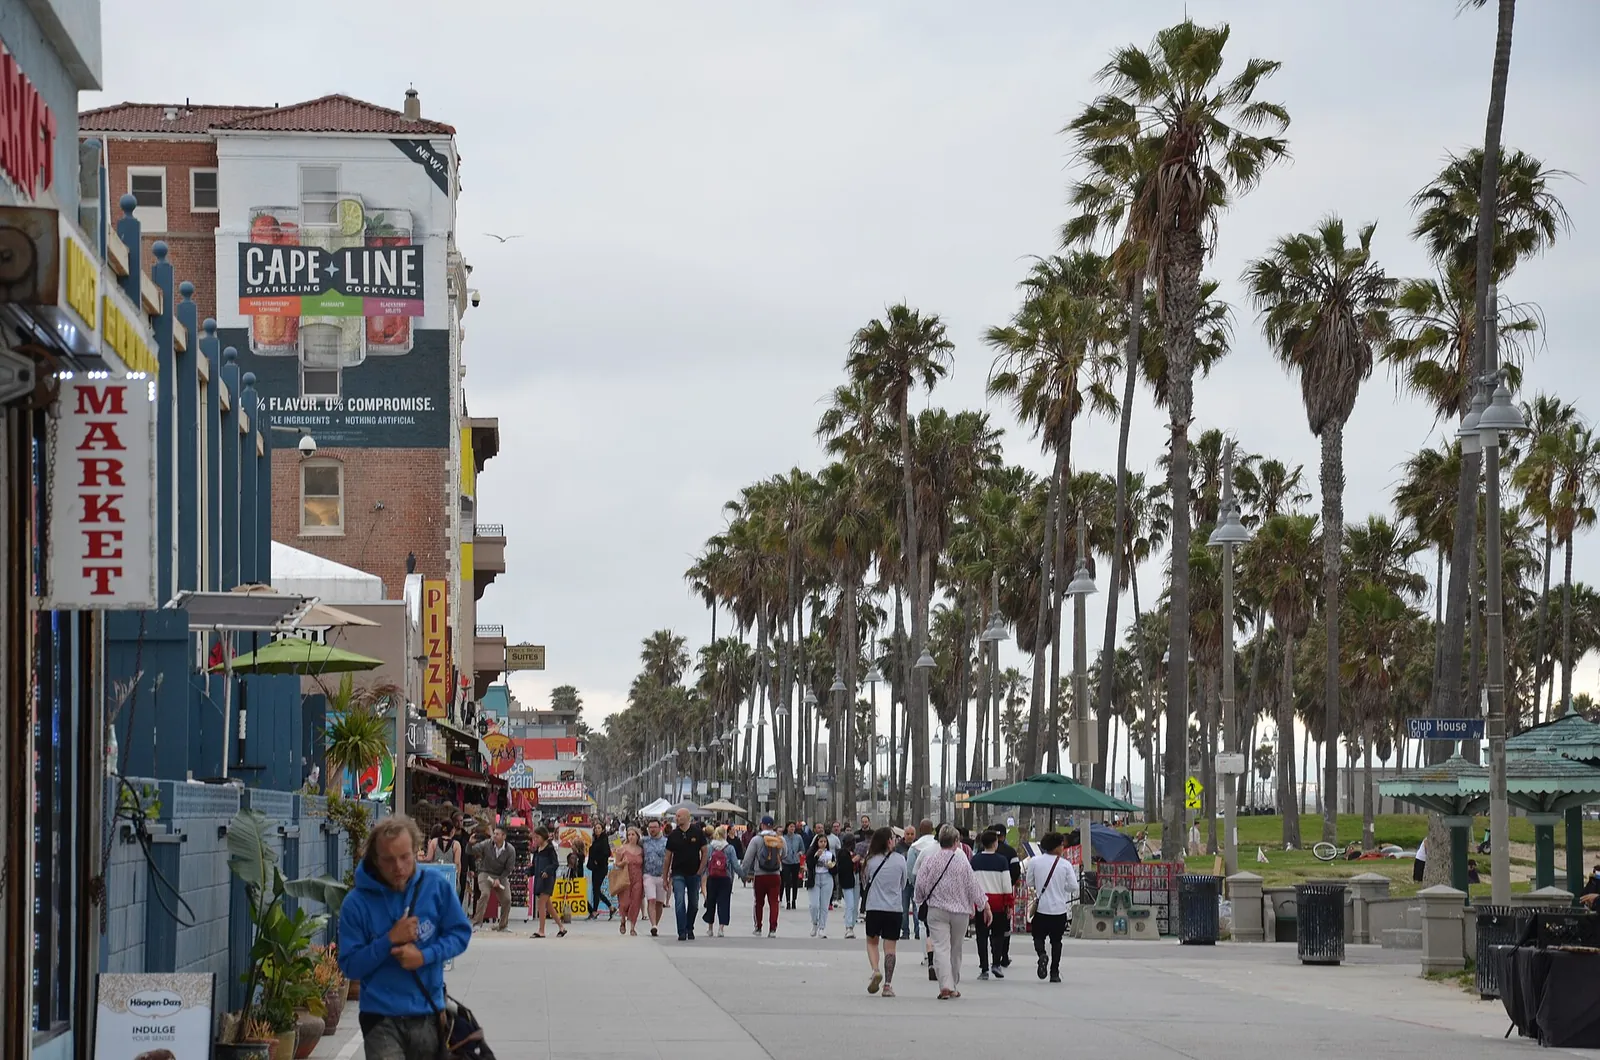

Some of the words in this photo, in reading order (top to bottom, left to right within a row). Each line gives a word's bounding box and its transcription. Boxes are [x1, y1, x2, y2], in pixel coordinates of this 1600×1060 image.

[415, 145, 443, 172] NEW!
[246, 247, 320, 286] CAPE
[345, 249, 416, 287] LINE
[246, 285, 320, 294] SPARKLING
[346, 286, 417, 296] COCKTAILS
[269, 397, 321, 411] FLAVOR.
[325, 397, 344, 412] 0%
[349, 397, 435, 412] COMPROMISE.
[283, 415, 331, 425] INGREDIENTS
[345, 416, 377, 425] NOTHING
[378, 415, 416, 425] ARTIFICIAL
[73, 385, 128, 595] MARKET
[427, 589, 443, 709] PIZZA
[1410, 719, 1432, 731] Club
[1436, 720, 1467, 732] House
[1472, 731, 1482, 739] Av
[542, 783, 575, 791] RENTALS
[557, 881, 580, 894] TOE
[132, 1026, 175, 1034] INDULGE
